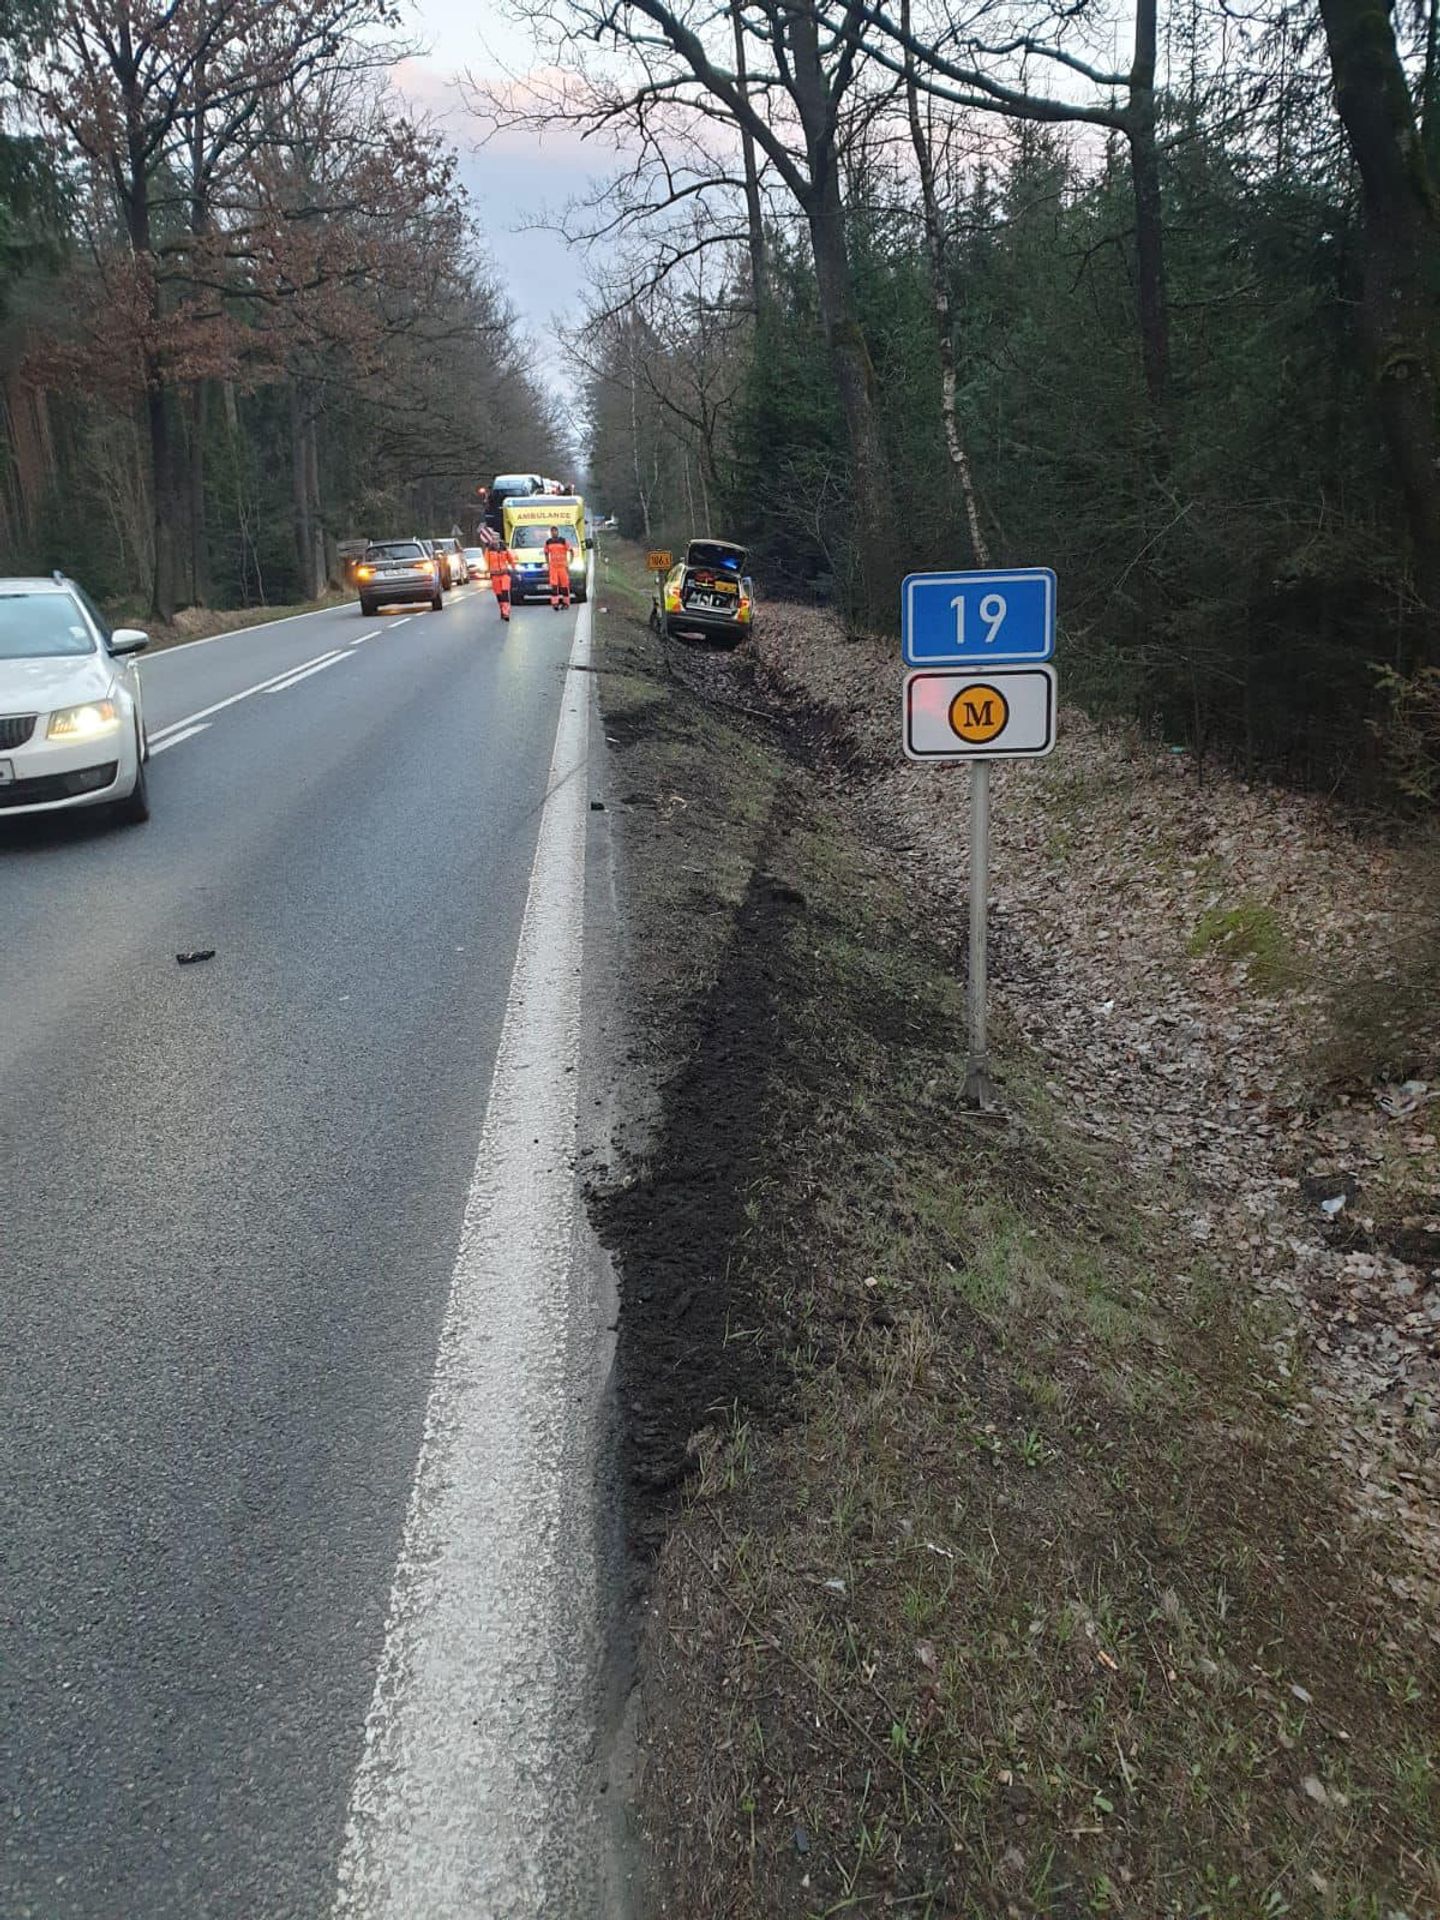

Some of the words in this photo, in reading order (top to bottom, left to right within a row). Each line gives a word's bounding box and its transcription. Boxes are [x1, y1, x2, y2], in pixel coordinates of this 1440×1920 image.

[517, 511, 572, 520] AMBULANCE
[950, 594, 1007, 645] 19
[963, 700, 995, 728] M
